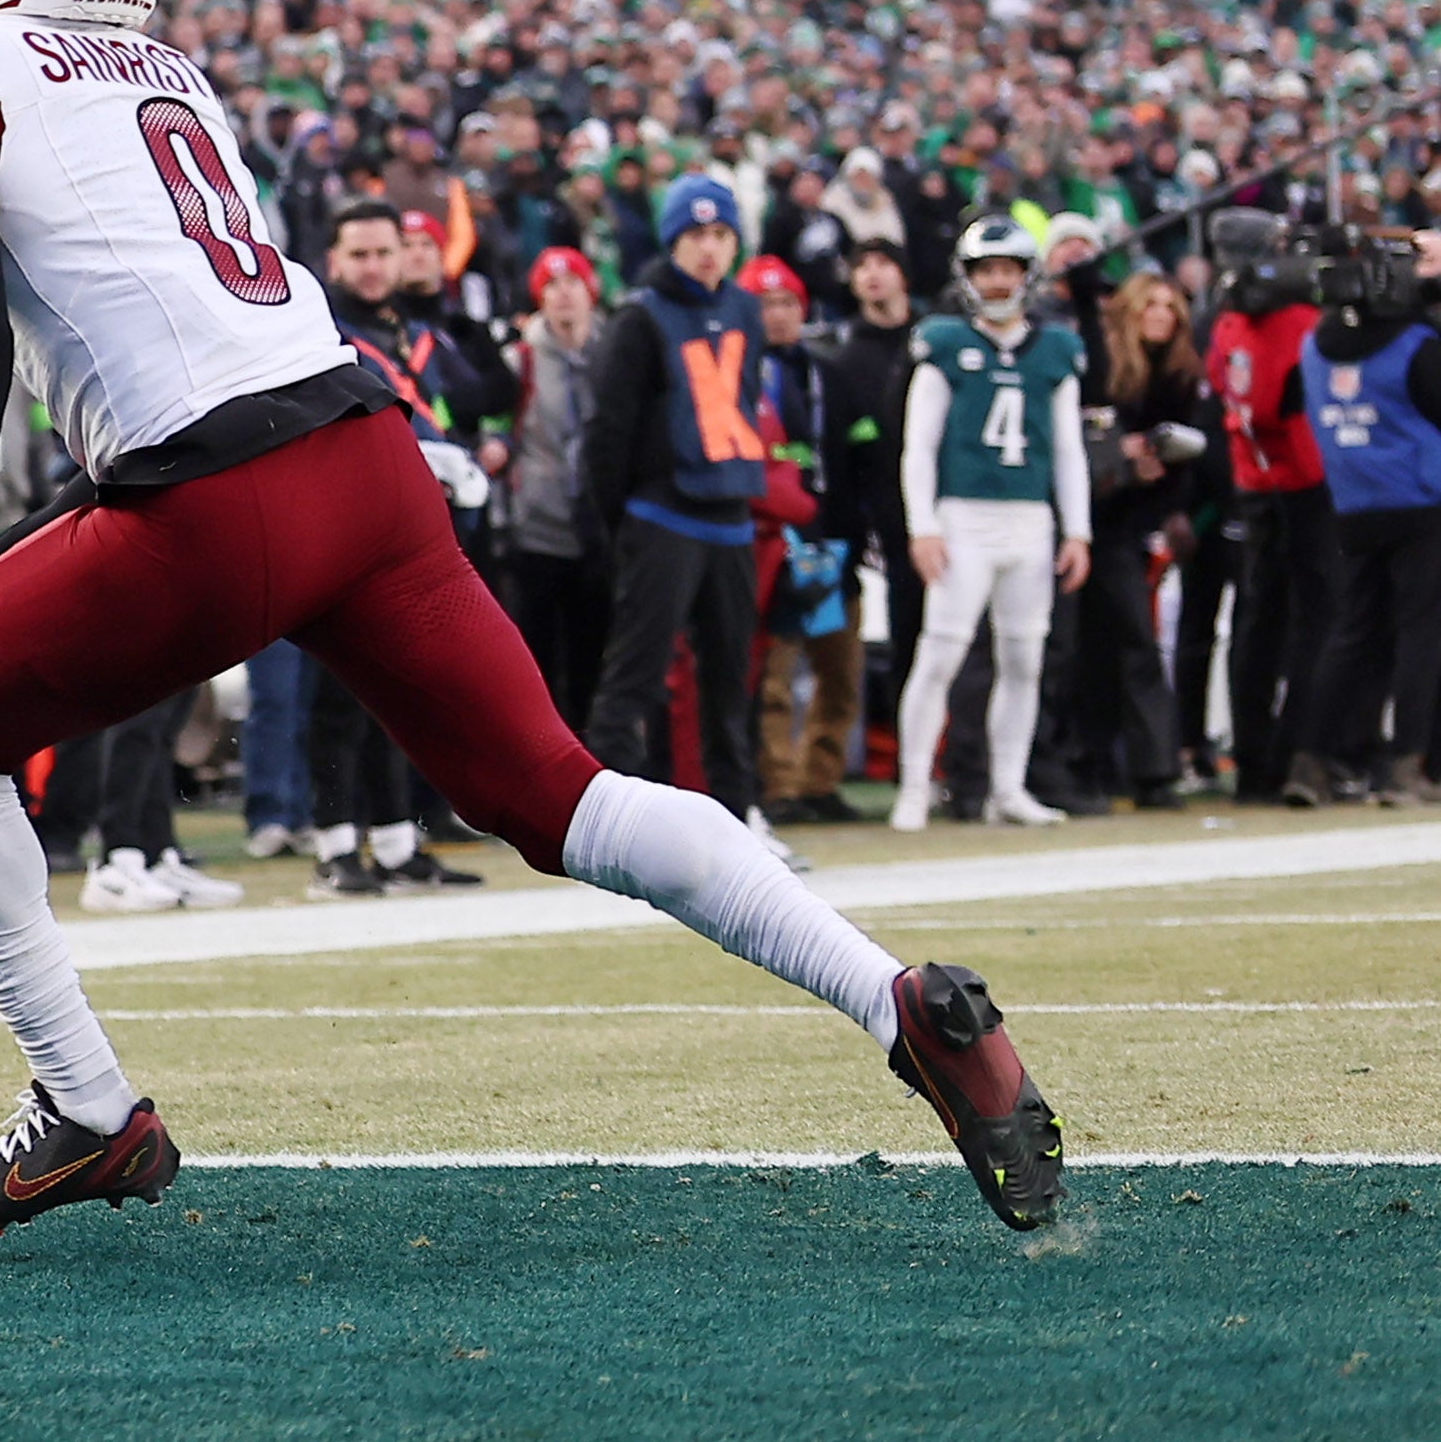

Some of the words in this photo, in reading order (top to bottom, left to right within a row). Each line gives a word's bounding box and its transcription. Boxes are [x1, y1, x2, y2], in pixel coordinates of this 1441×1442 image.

[137, 96, 292, 306] 0
[680, 329, 765, 463] K
[981, 385, 1029, 467] 4
